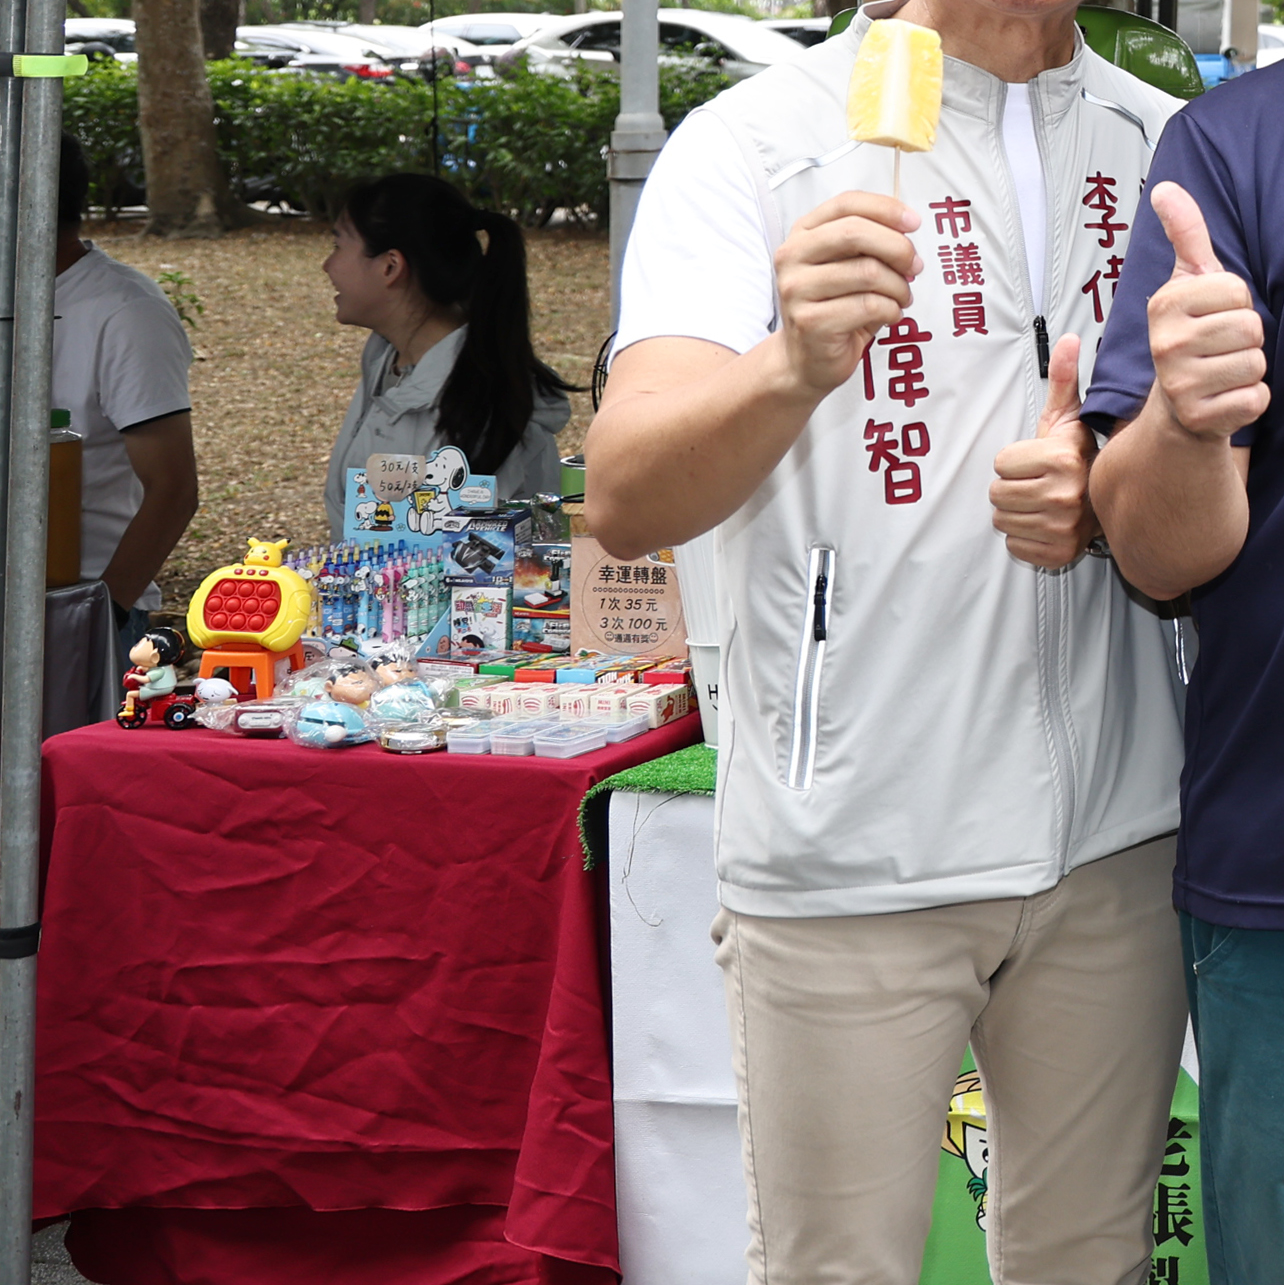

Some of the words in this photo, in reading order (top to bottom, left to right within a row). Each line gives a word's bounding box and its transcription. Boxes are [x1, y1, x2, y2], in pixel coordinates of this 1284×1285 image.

[928, 196, 989, 338] 市議員
[861, 316, 933, 506] 偉智
[598, 565, 668, 585] 幸運轉盤
